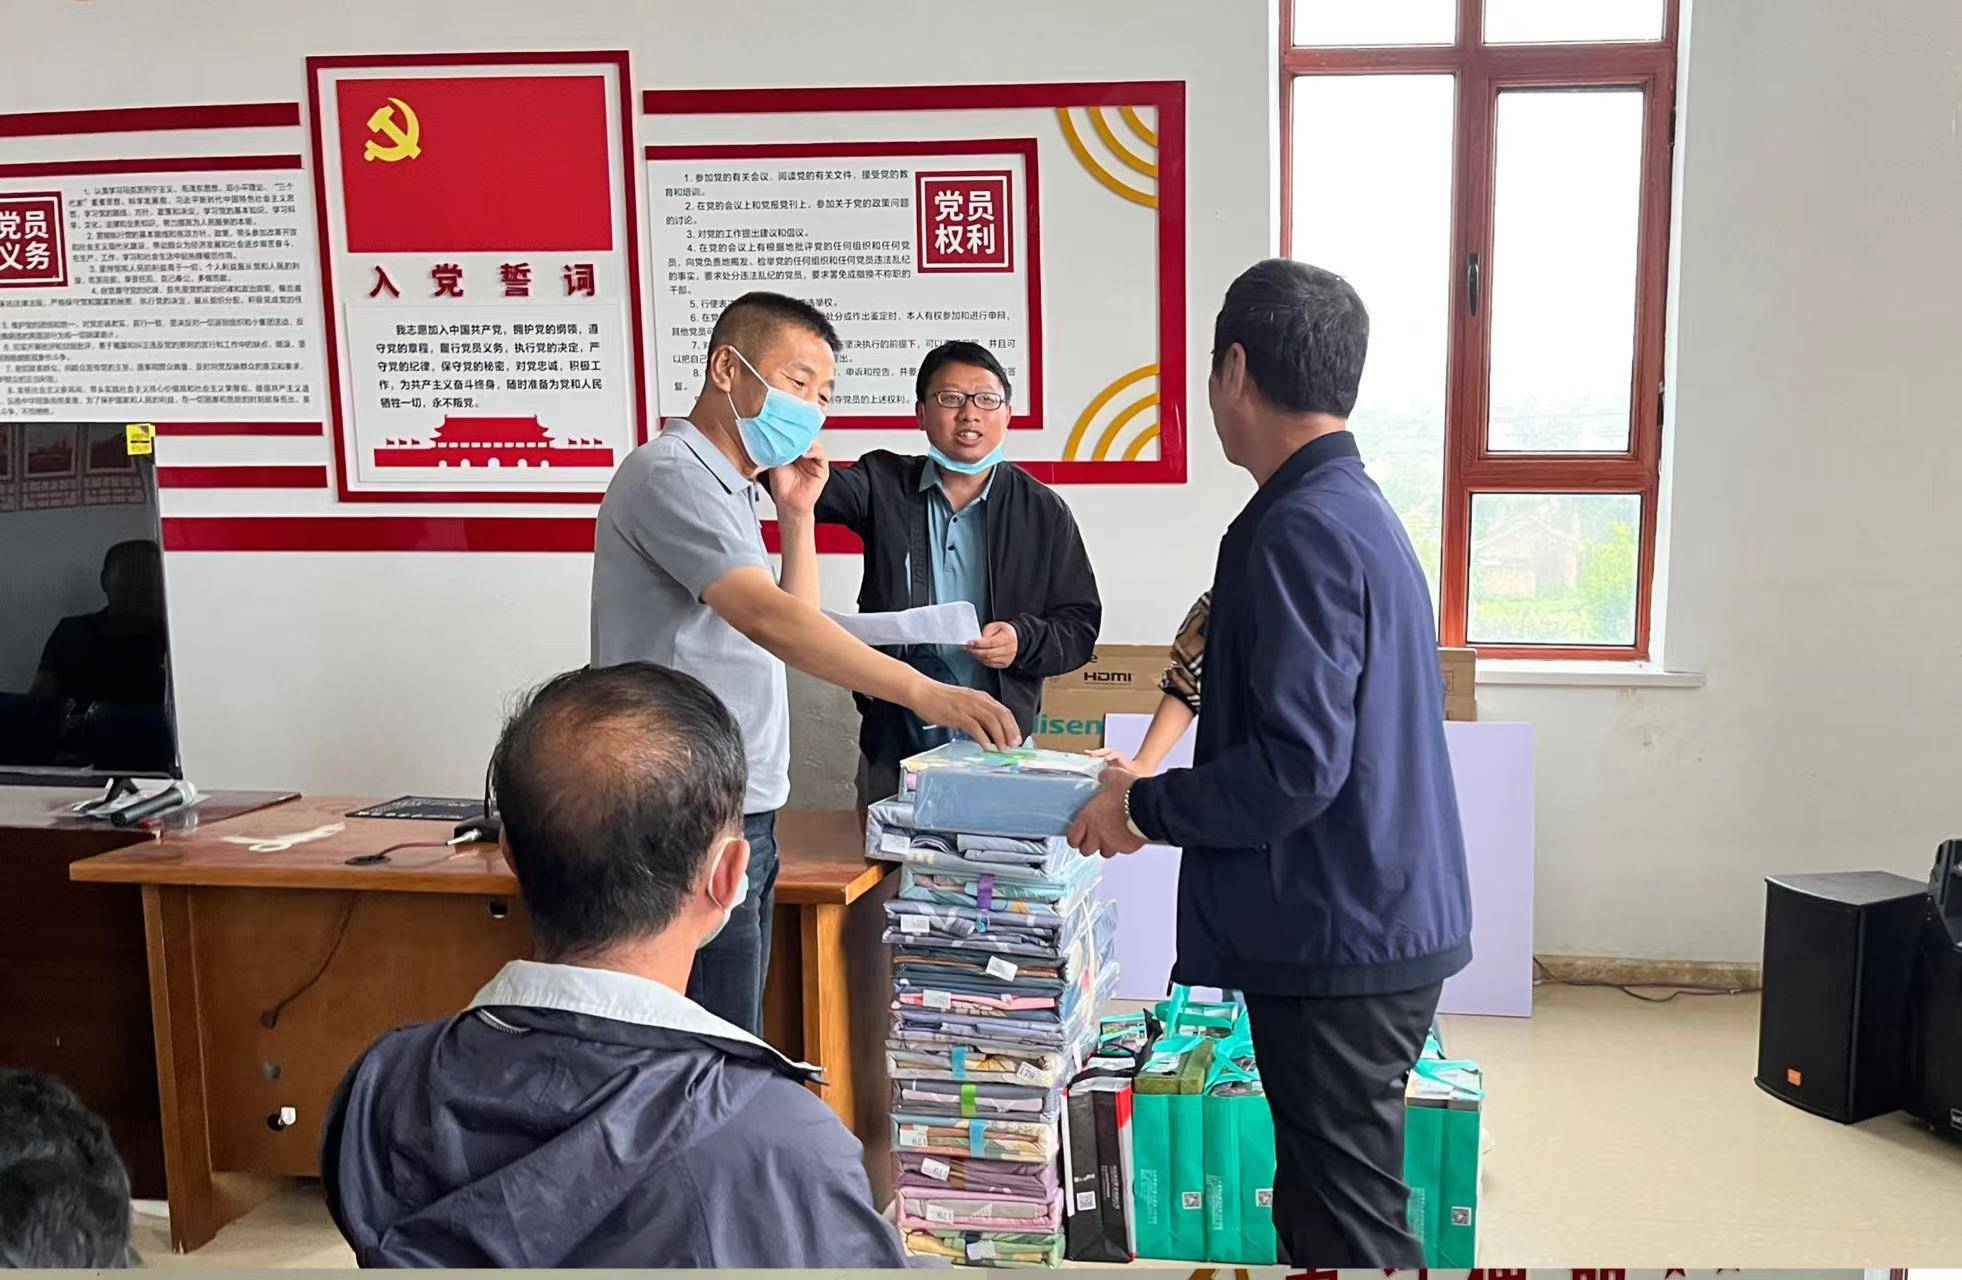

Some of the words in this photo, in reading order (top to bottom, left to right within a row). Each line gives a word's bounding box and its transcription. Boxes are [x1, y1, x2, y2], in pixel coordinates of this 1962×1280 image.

[934, 190, 995, 221] 党员
[0, 210, 49, 239] 党员
[934, 223, 996, 255] 权利
[0, 246, 50, 270] 义务
[369, 263, 596, 298] 入党誓词
[396, 323, 599, 336] 我志愿加入中国共产党，拥护党的纲领，遵
[376, 341, 600, 354] 守党的章程，履行党员义务，执行党的决定，严
[377, 359, 601, 372] 守党的纪律，保守党的秘密，对党忠诚，积极工
[378, 378, 603, 390] 作，为共产主义奋斗终身，随时准备为党和人民
[380, 397, 479, 409] 牺牲一切，永不叛党。
[1084, 672, 1132, 682] HDMI
